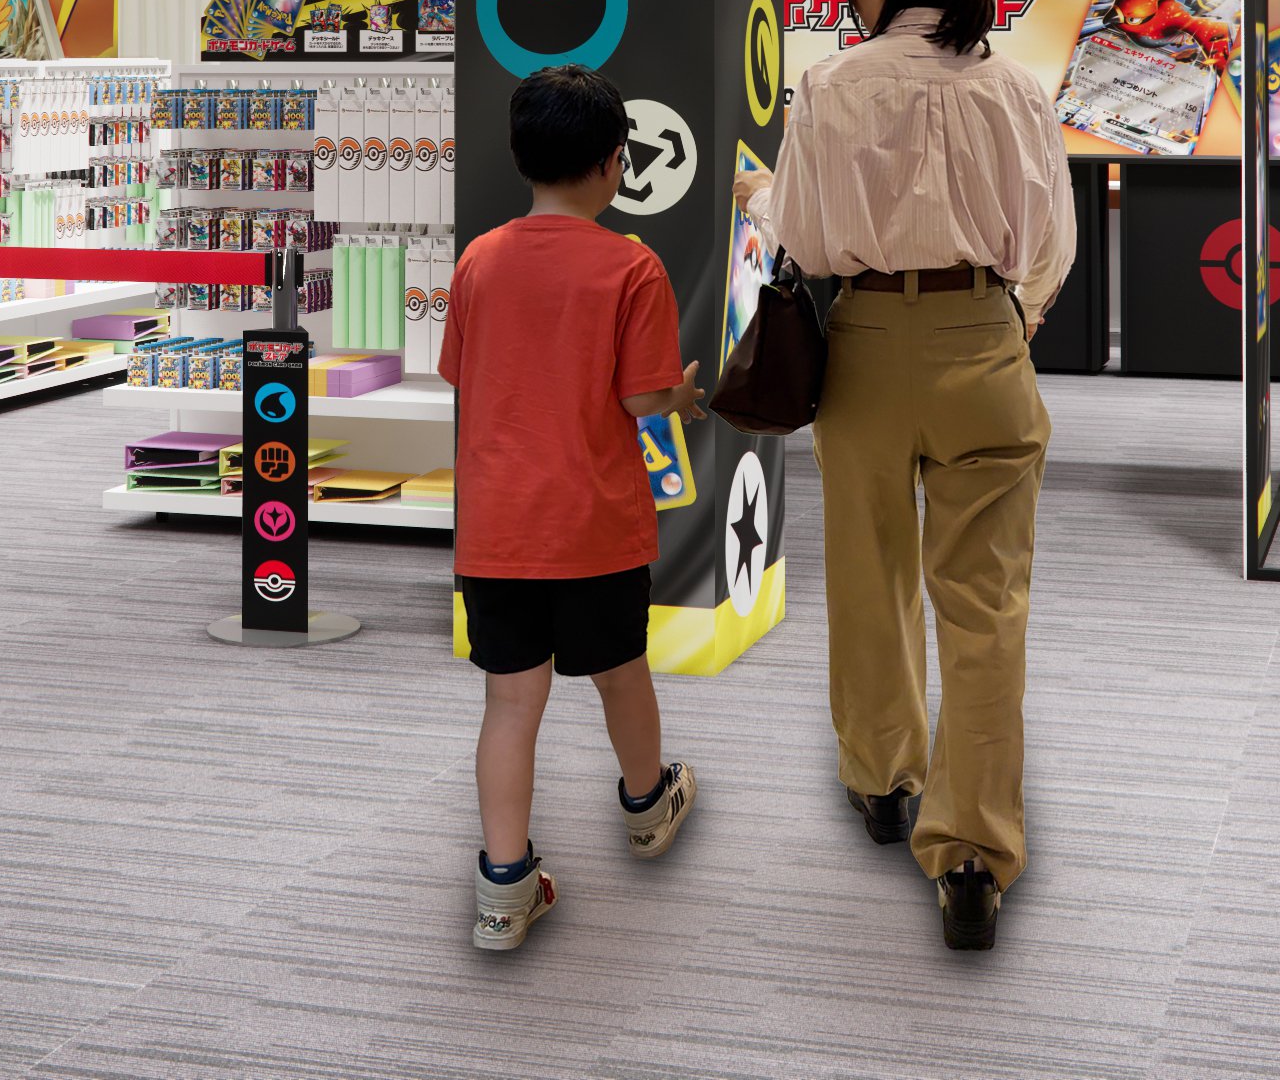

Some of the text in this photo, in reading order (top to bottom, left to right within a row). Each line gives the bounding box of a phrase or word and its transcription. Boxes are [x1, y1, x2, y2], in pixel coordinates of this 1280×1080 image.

[207, 39, 296, 51] ポケモンカードゲーム
[1184, 103, 1197, 113] 150
[247, 341, 304, 353] ポケモンカード
[261, 351, 288, 362] ストア
